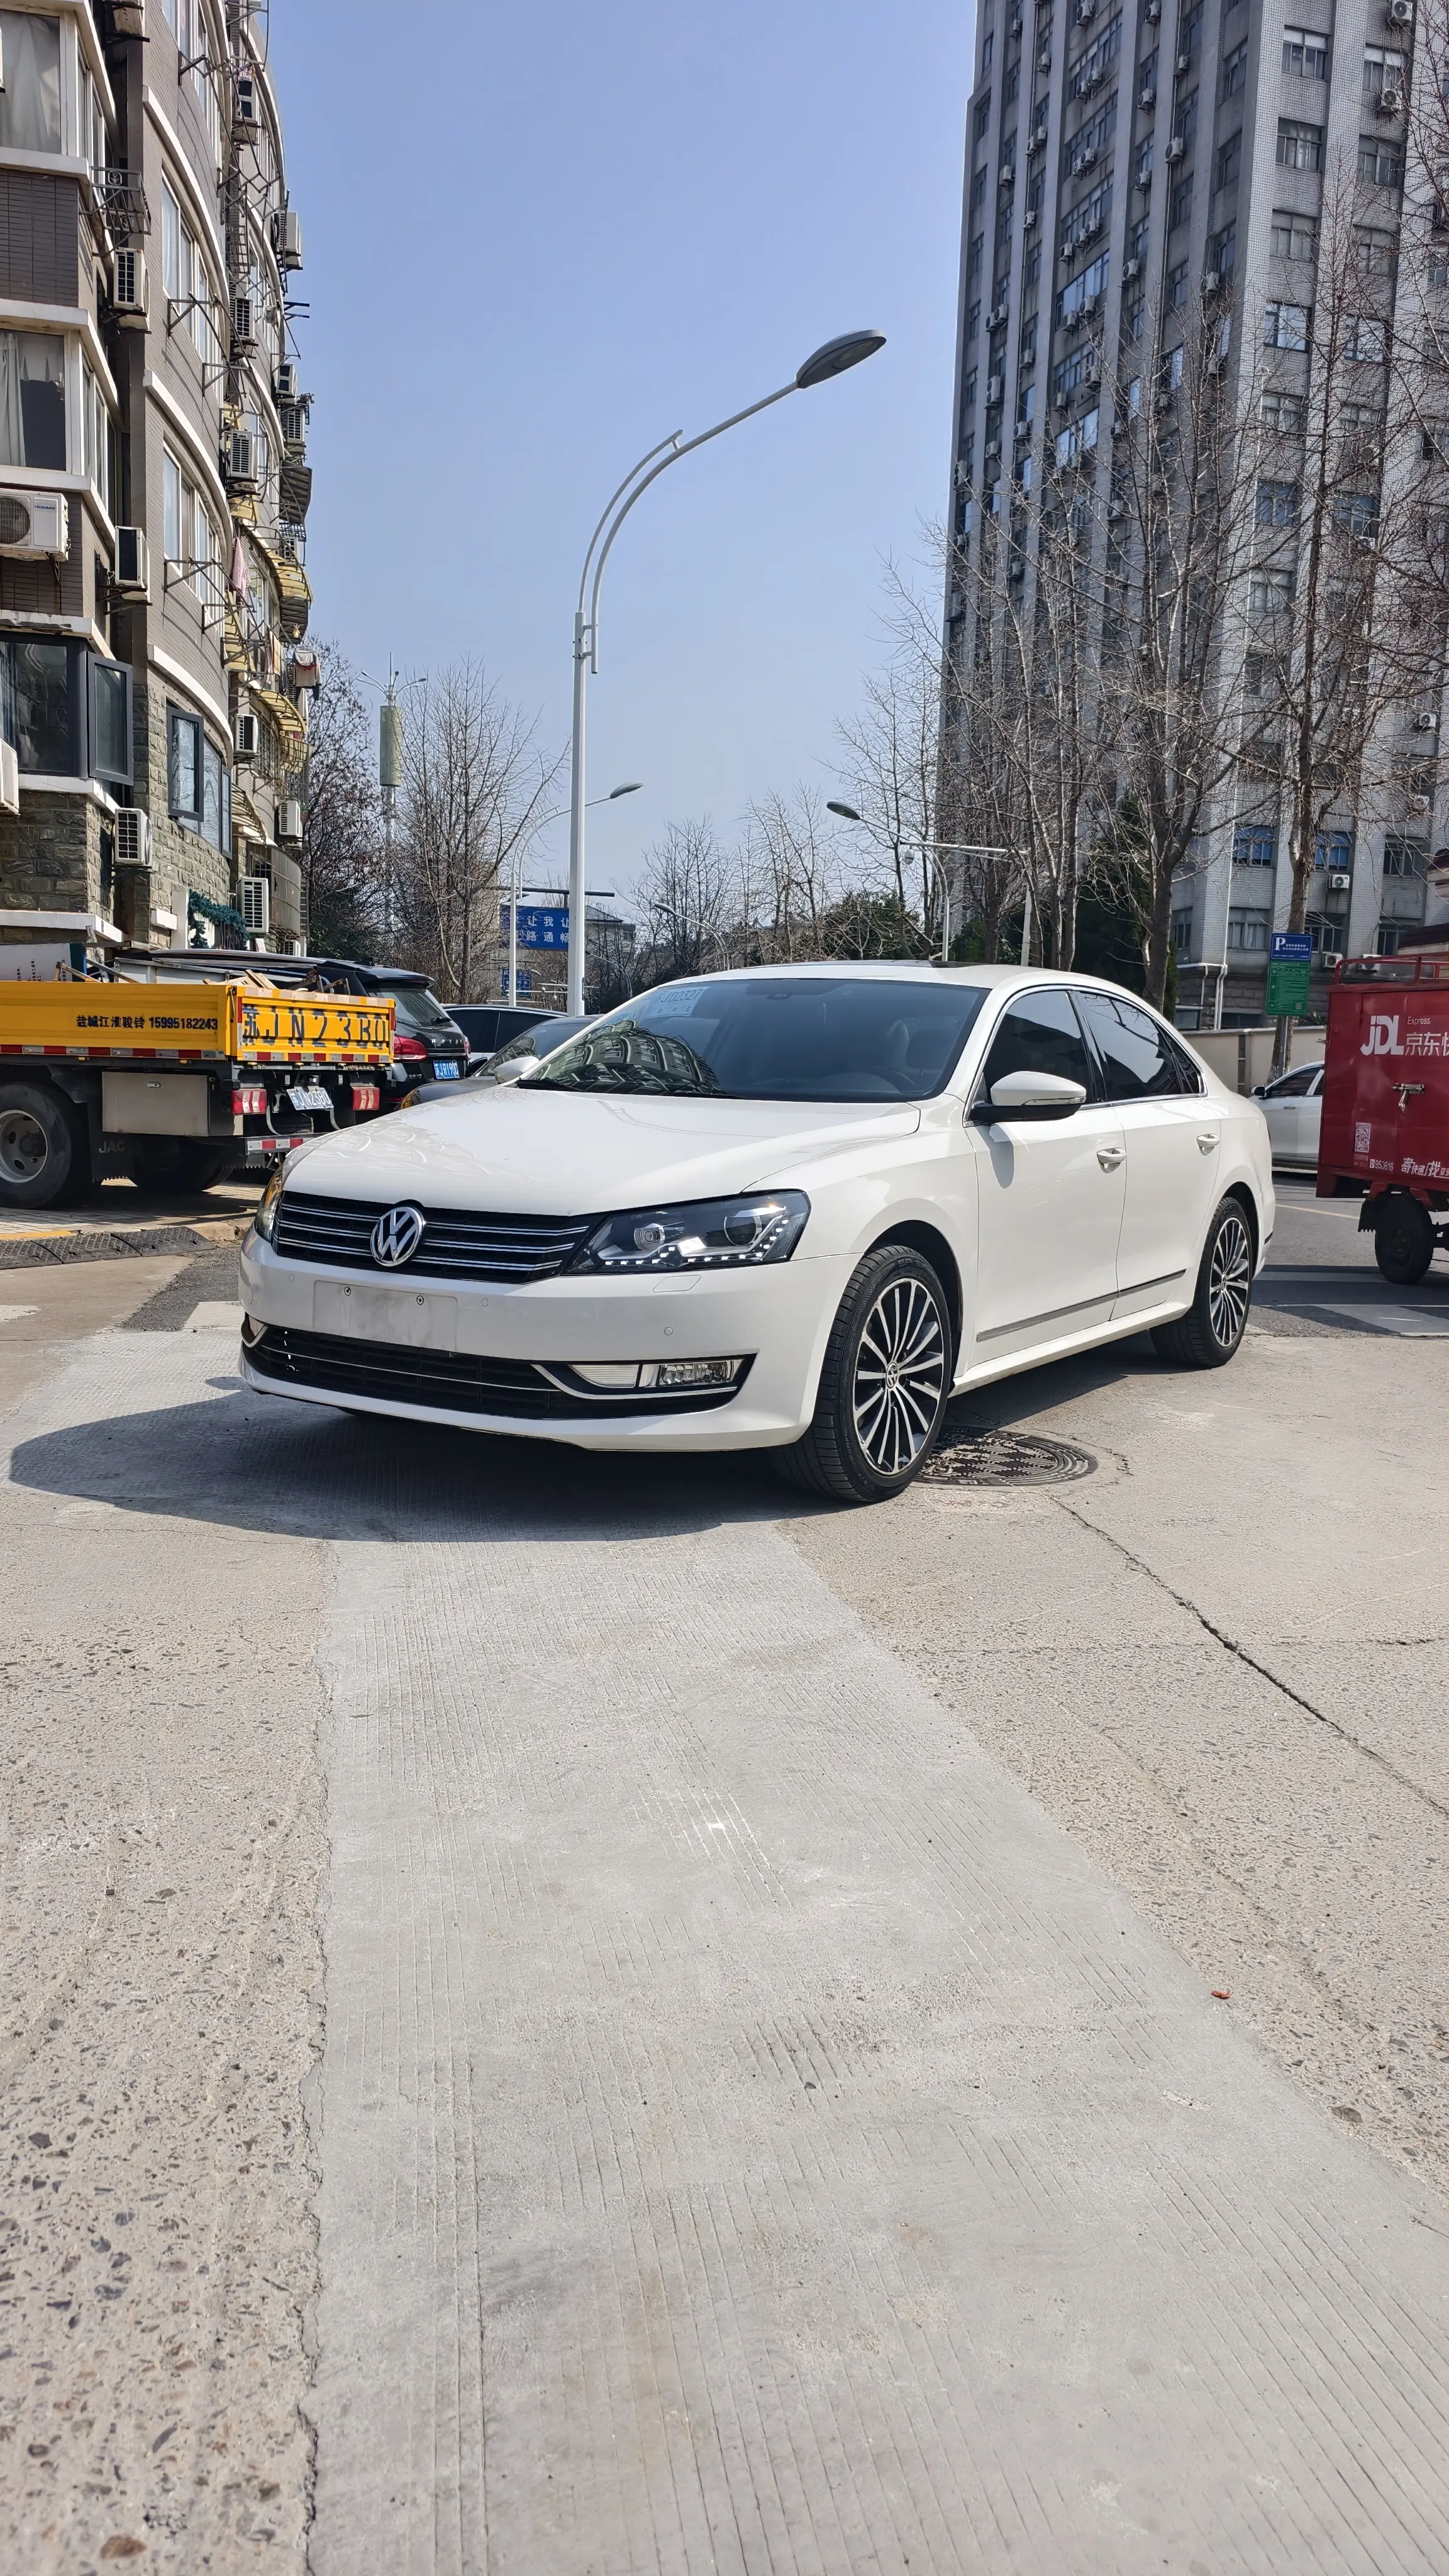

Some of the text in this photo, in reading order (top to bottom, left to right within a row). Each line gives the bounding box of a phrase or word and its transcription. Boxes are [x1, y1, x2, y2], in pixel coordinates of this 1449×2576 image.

[1274, 937, 1286, 950] P
[76, 1015, 218, 1030] 盐城江淮骏铃 15995182243
[1407, 1017, 1431, 1026] Express
[99, 1140, 125, 1153] JAC
